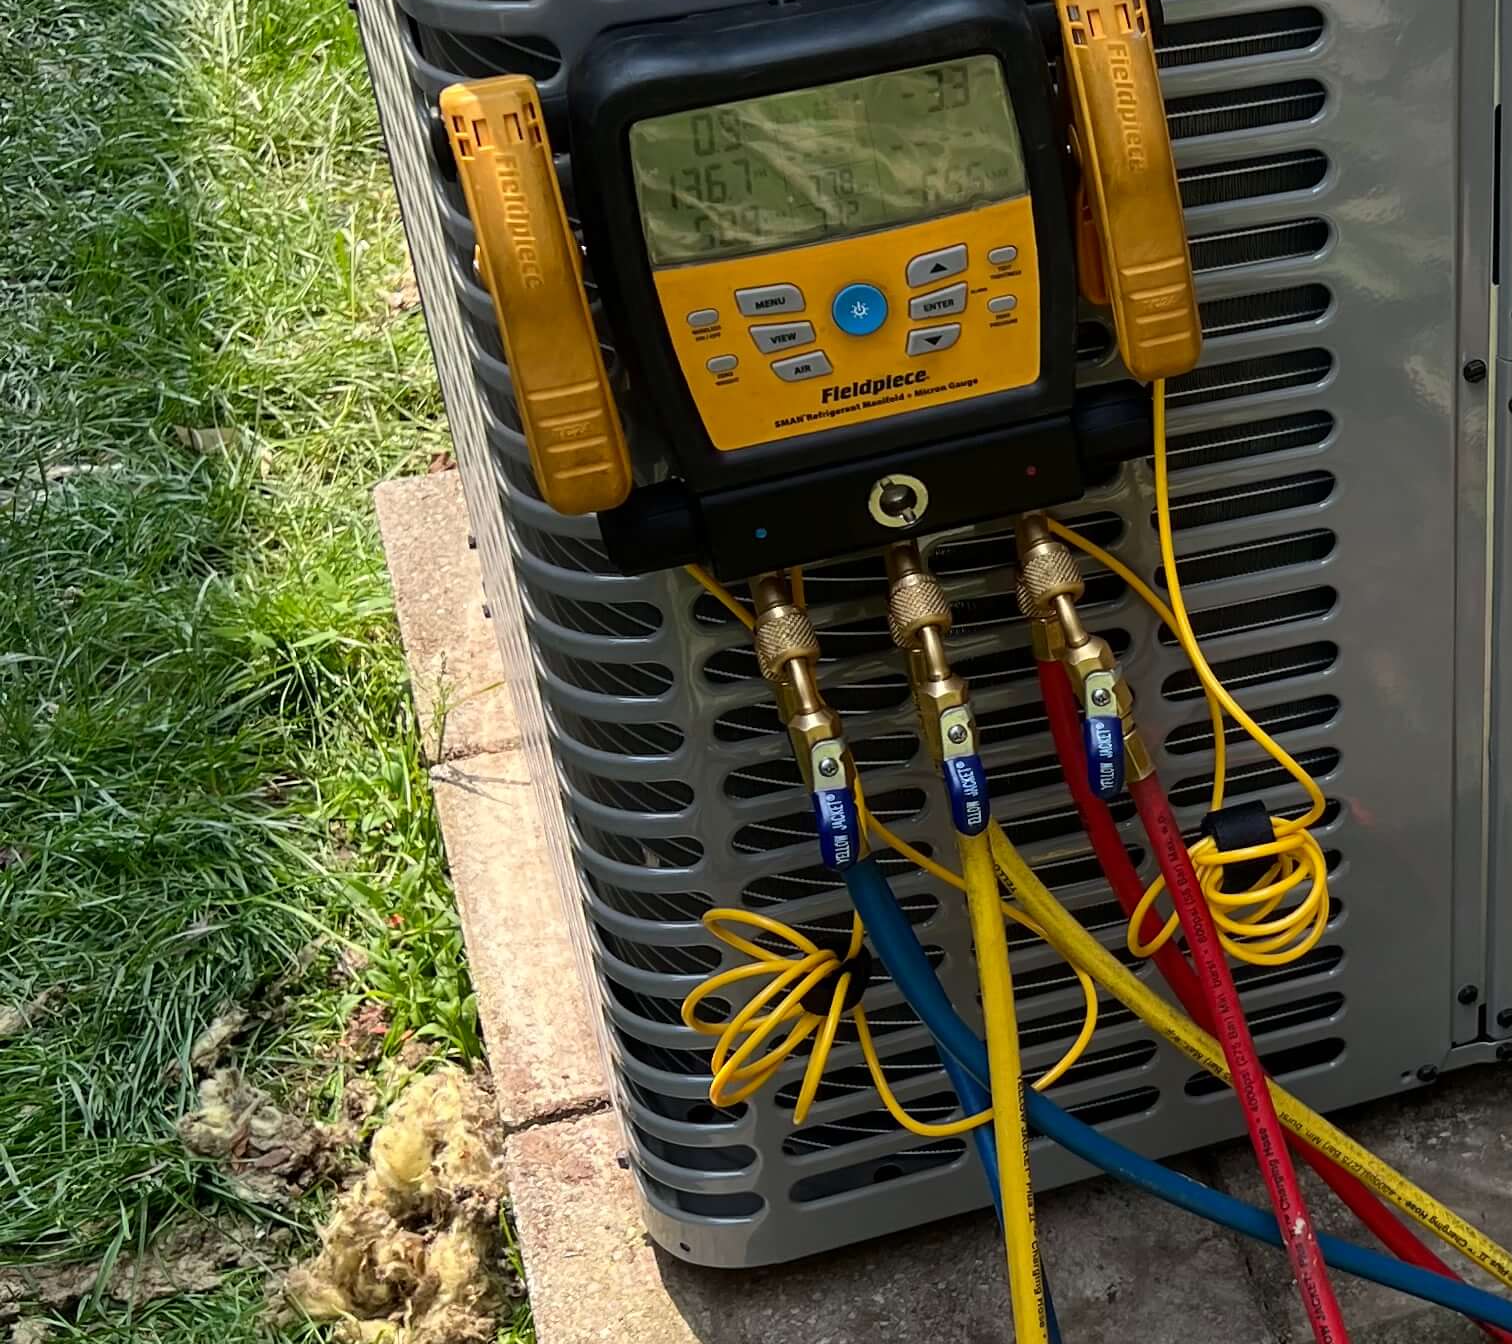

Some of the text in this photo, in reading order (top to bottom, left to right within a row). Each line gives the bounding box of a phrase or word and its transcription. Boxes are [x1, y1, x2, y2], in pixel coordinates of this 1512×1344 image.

[1105, 41, 1146, 172] Fieldpiece
[495, 153, 544, 290] Fieldpiece
[755, 296, 786, 310] MENU
[923, 298, 954, 312] ENTER
[770, 332, 797, 345] VIEW
[794, 364, 812, 376] AIR
[805, 403, 862, 422] Refrigerant
[862, 393, 905, 409] Manifold
[914, 384, 948, 398] Micron
[948, 377, 979, 391] Gauge
[821, 369, 928, 404] Fieldpiece
[1099, 757, 1116, 792] YELLOW
[834, 835, 852, 868] YELLOW
[1174, 863, 1189, 886] Bar)
[1181, 886, 1197, 910] (55
[1205, 957, 1223, 990] burst
[1223, 1016, 1239, 1041] Bar)
[1231, 1042, 1249, 1068] (275
[1239, 1070, 1259, 1112] 4000psi
[1278, 1111, 1303, 1131] burst
[1258, 1126, 1272, 1157] Hose
[1321, 1141, 1343, 1159] Bar)
[1268, 1158, 1291, 1211] Charging
[1404, 1199, 1429, 1220] Hose
[1429, 1214, 1468, 1248] Charging
[1489, 1259, 1510, 1277] Plus
[1031, 1240, 1043, 1295] Charging
[1037, 1297, 1047, 1328] Hose
